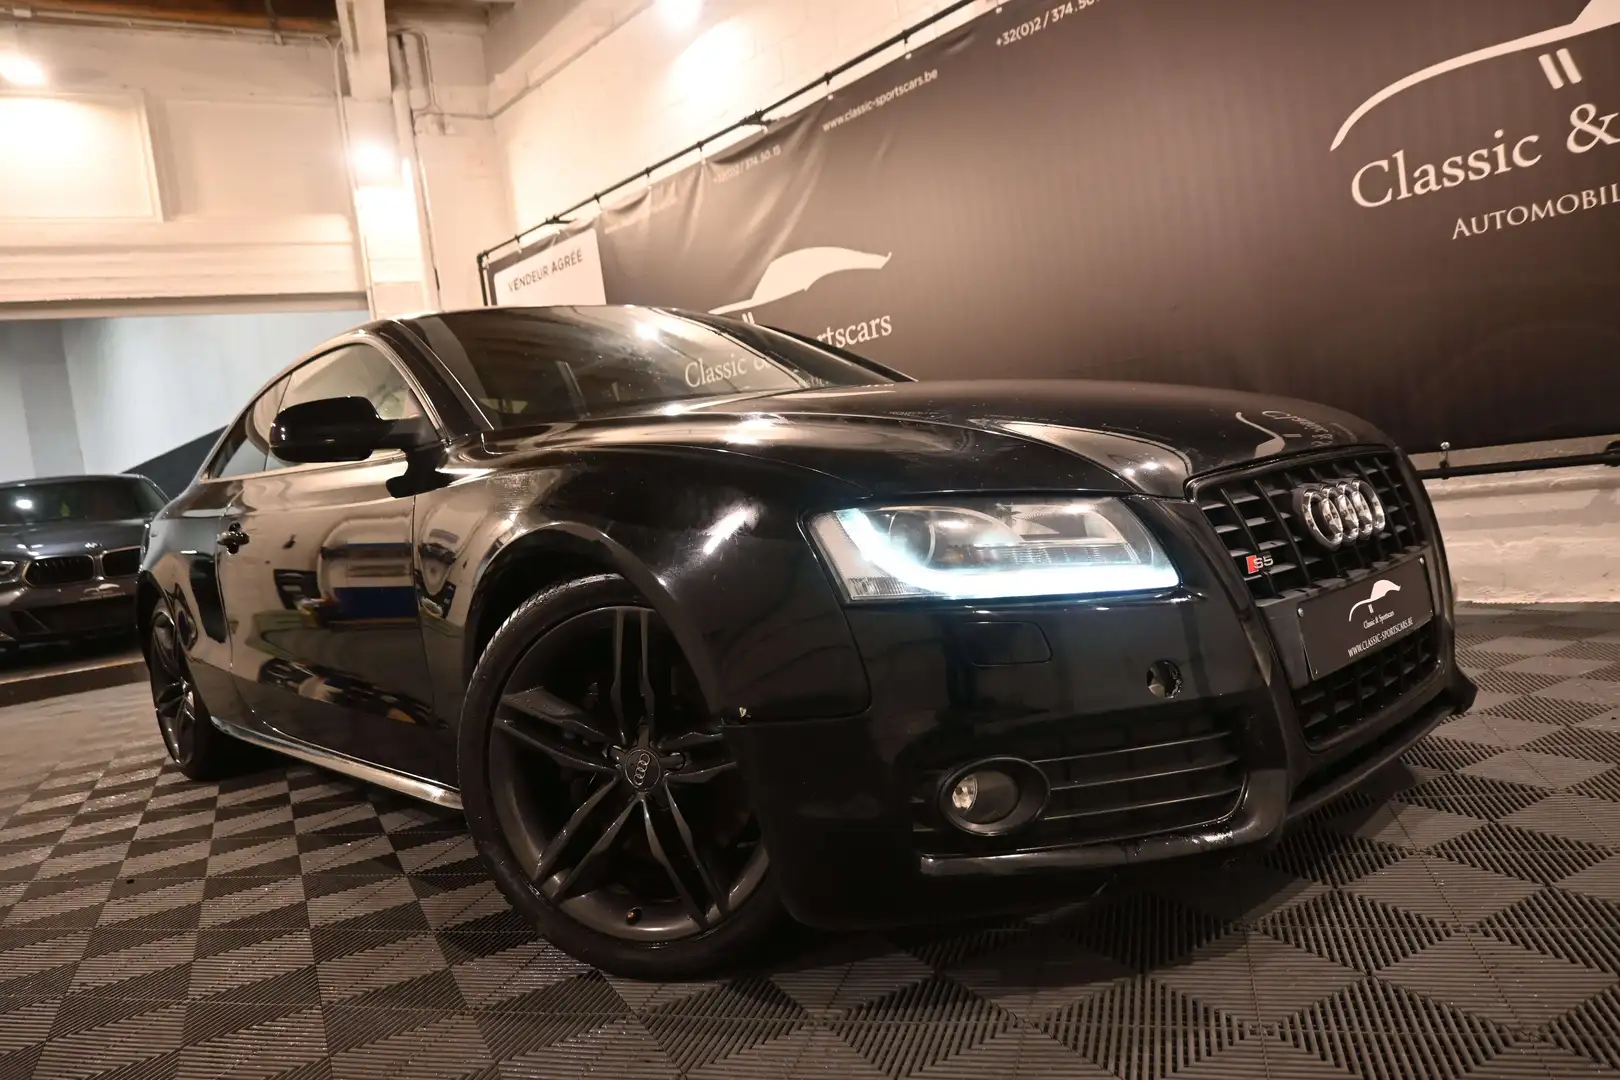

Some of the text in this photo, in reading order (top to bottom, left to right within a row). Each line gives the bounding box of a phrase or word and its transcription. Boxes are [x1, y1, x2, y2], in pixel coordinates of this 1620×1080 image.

[996, 17, 1042, 47] +32(0)2
[822, 68, 939, 132] www.classic-sportscars.be
[1351, 103, 1620, 208] Classic &
[1452, 183, 1620, 240] AUTOMOBIL
[508, 248, 583, 292] VENDEUR AGRÉE
[684, 353, 748, 388] Classic
